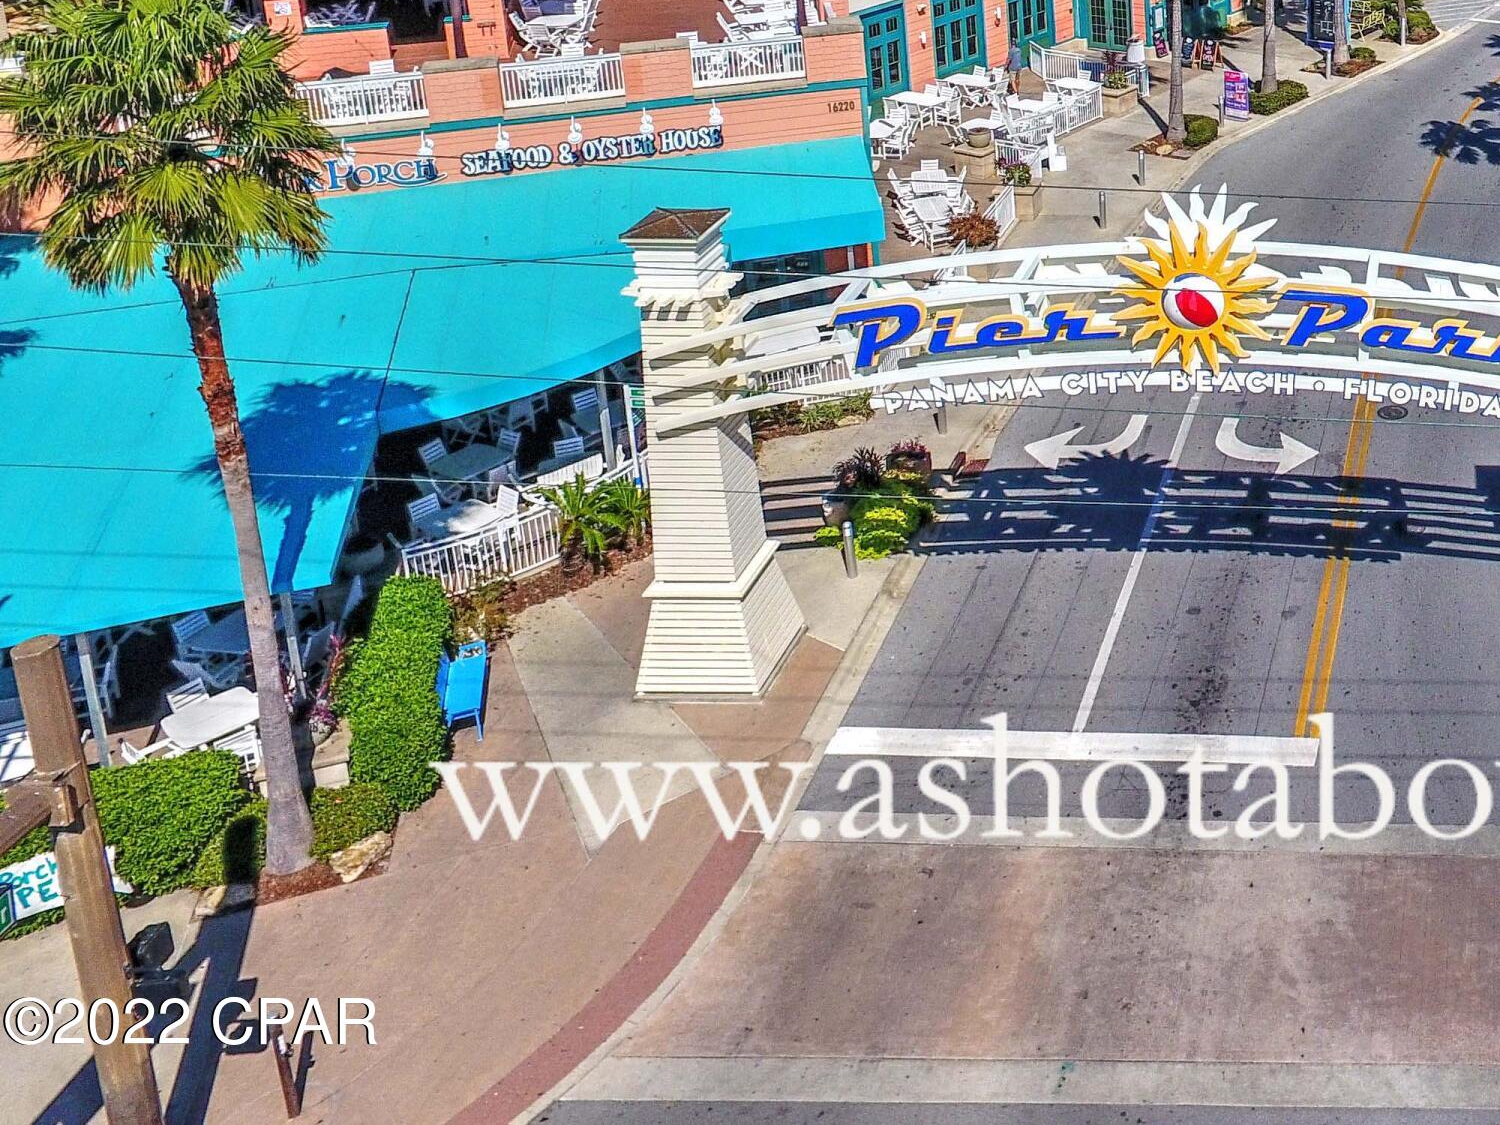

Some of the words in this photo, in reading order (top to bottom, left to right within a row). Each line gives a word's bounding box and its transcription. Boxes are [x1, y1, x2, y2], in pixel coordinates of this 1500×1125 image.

[827, 101, 855, 114] 16220
[322, 156, 440, 192] PORCH
[461, 145, 552, 177] SEAFOOD
[558, 146, 577, 166] &
[581, 133, 657, 163] OYSTER
[659, 125, 723, 154] HOUSE
[833, 296, 1127, 372] Pier
[881, 374, 1044, 415] PANAMA
[1059, 367, 1153, 396] CITY
[1170, 367, 1296, 397] BEACH
